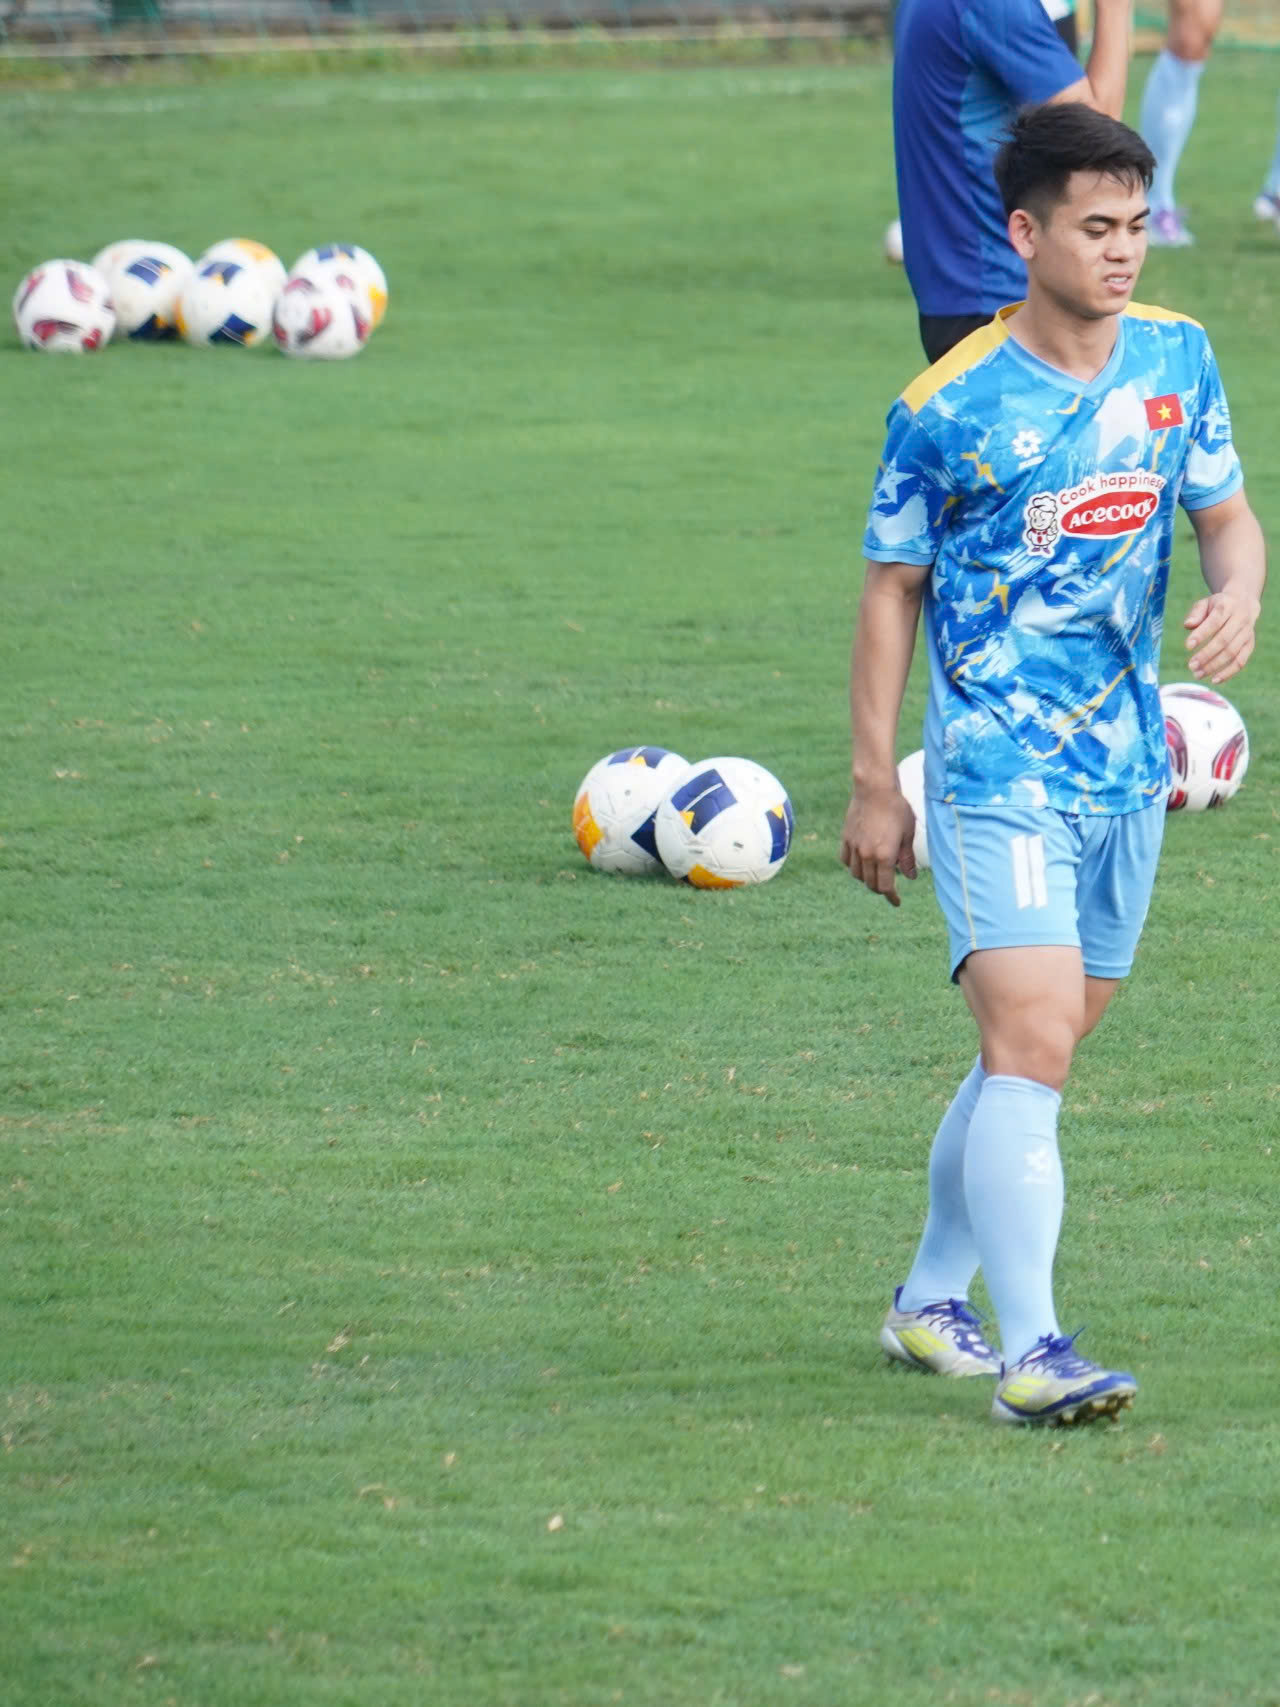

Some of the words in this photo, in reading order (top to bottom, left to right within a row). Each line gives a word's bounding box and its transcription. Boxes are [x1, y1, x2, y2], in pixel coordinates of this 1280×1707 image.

[1060, 480, 1095, 505] Cook
[1100, 472, 1164, 489] happiness
[1010, 833, 1048, 909] 11
